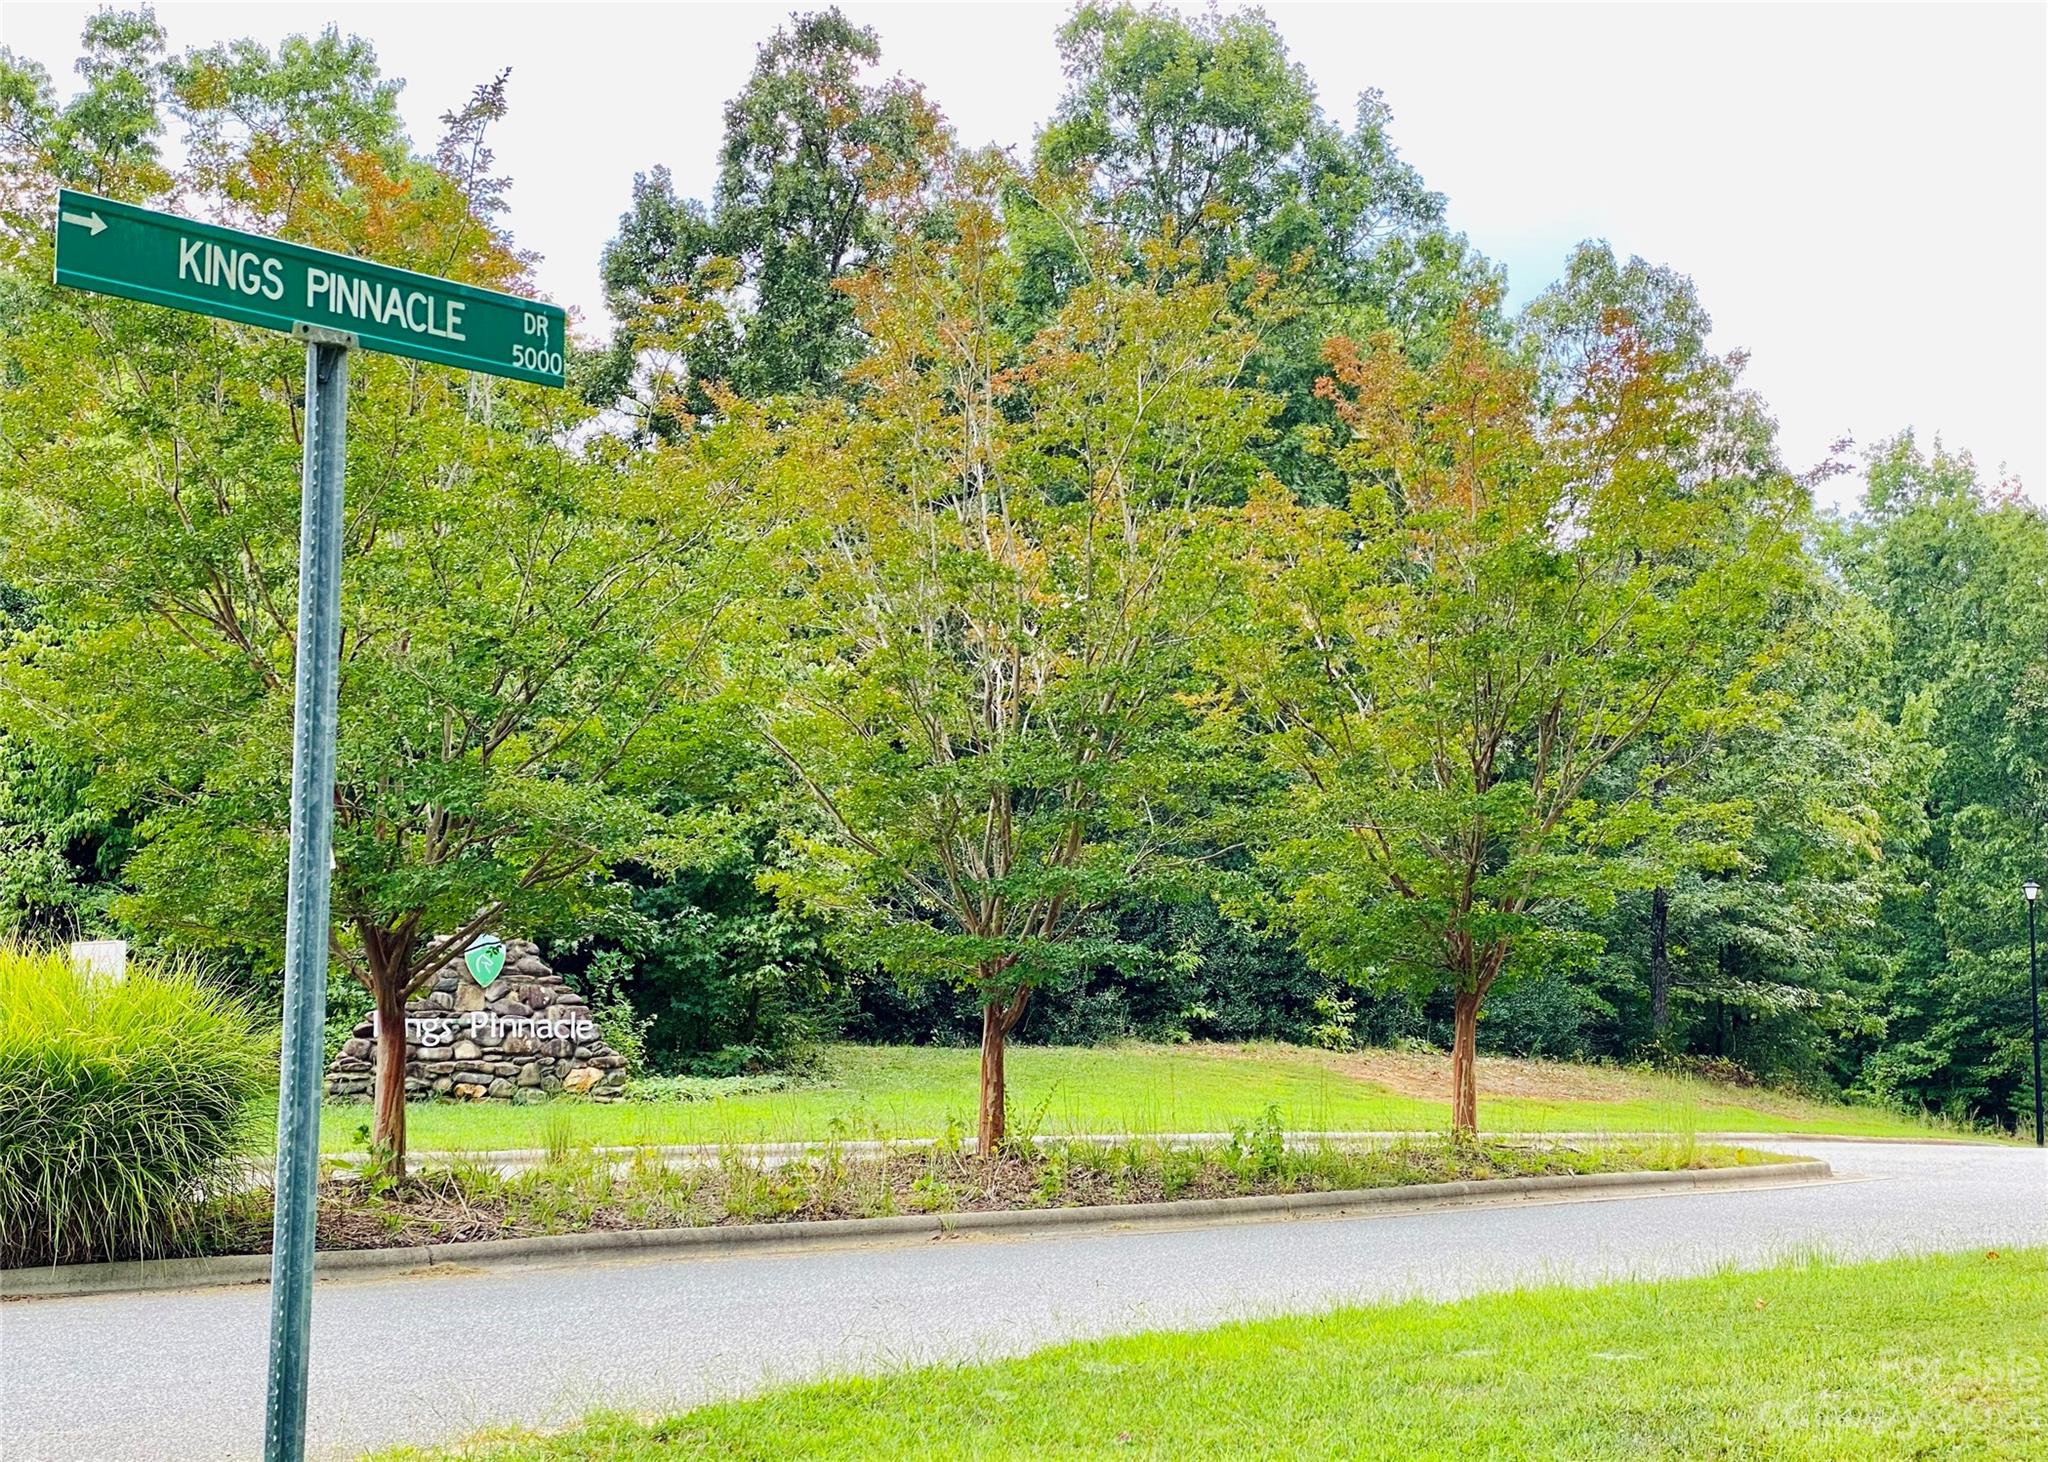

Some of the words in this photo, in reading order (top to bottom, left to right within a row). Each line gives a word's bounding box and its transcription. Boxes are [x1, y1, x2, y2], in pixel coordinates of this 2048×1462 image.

[178, 237, 284, 301] KINGS
[306, 267, 466, 341] PINNACLE
[523, 311, 549, 337] DR
[511, 343, 562, 375] 5000
[373, 1010, 452, 1047] ngs
[470, 1010, 594, 1040] Pinnacle
